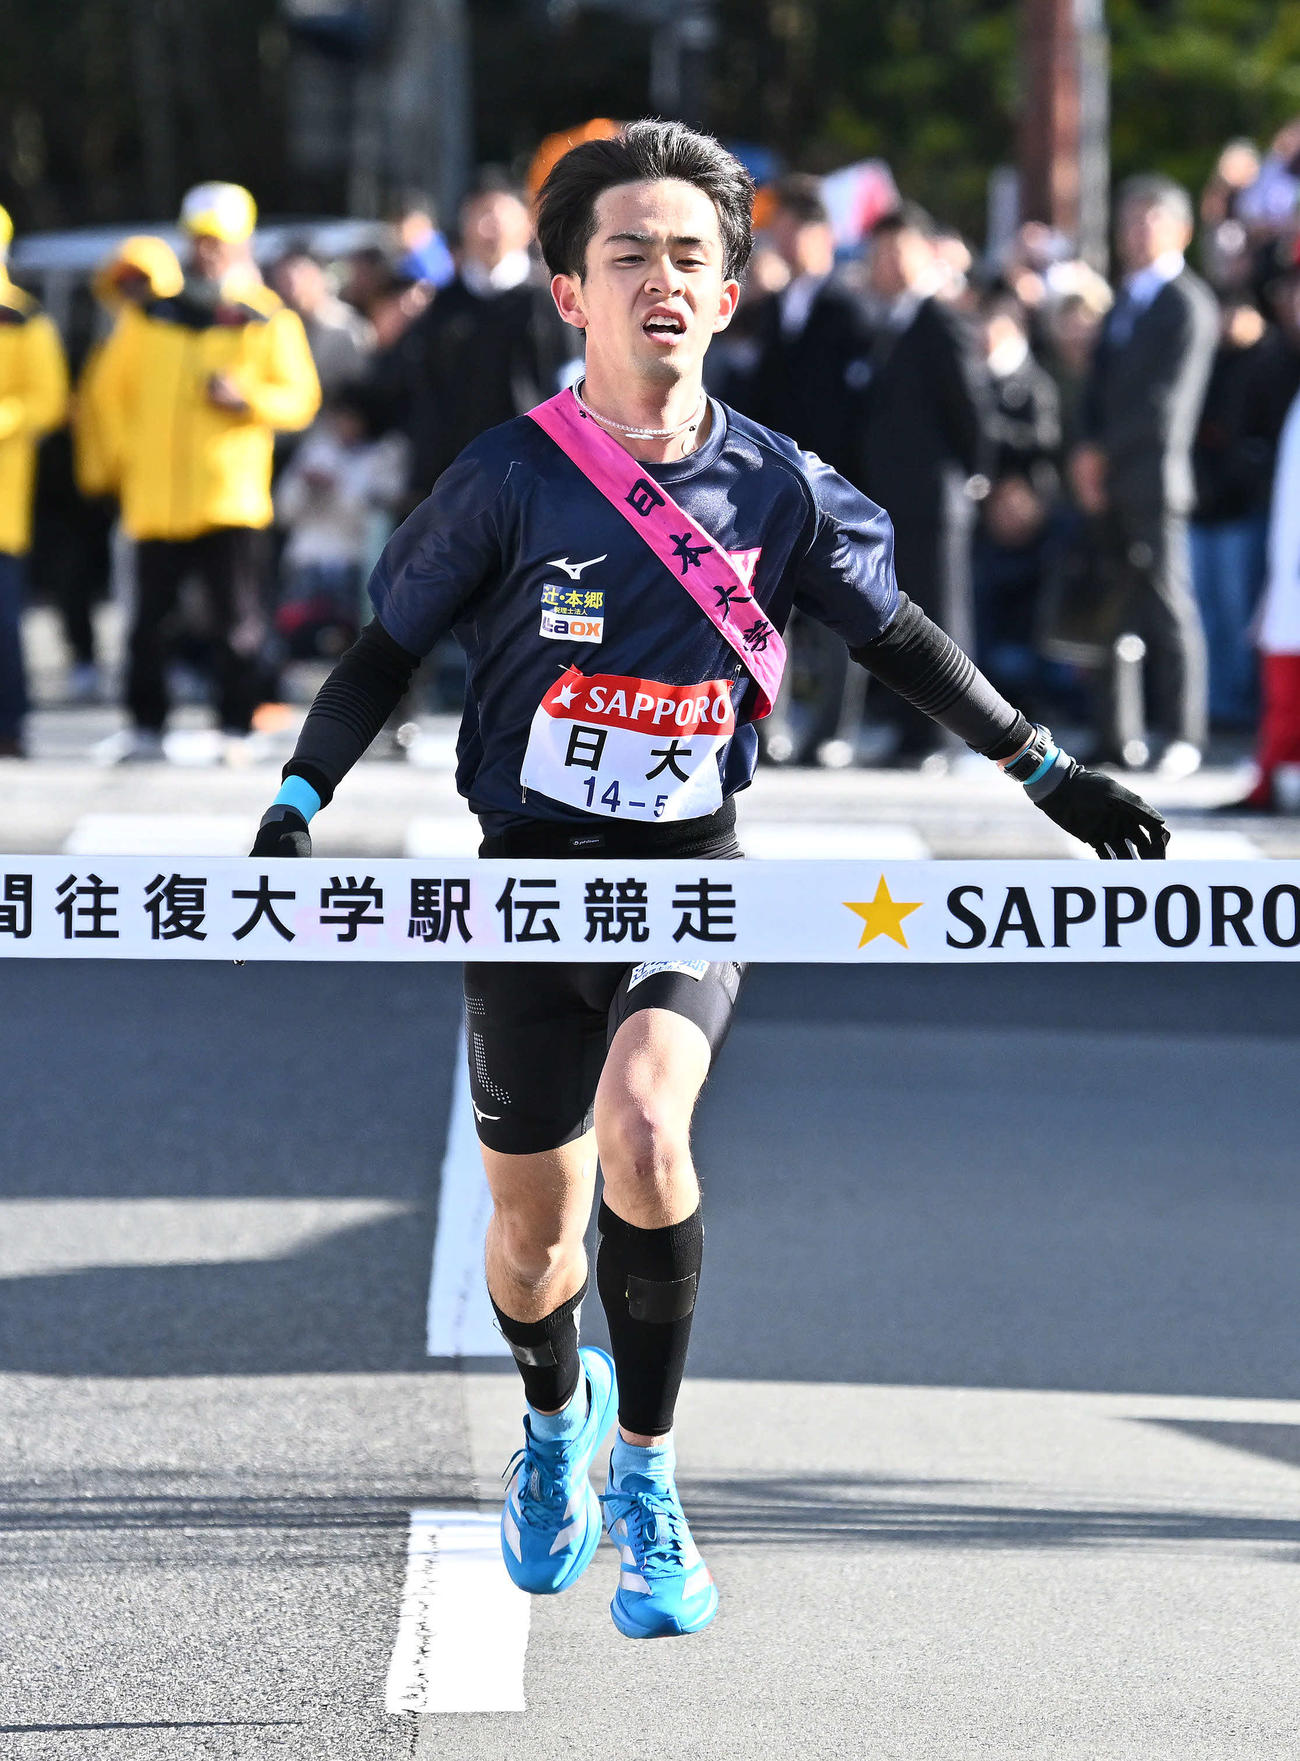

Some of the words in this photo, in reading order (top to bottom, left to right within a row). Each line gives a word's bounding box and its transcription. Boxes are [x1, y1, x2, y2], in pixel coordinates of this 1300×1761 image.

[624, 478, 774, 653] 日本大学
[585, 686, 730, 726] SAPPORO
[582, 775, 669, 818] 14-5
[945, 884, 1300, 949] SAPPORO
